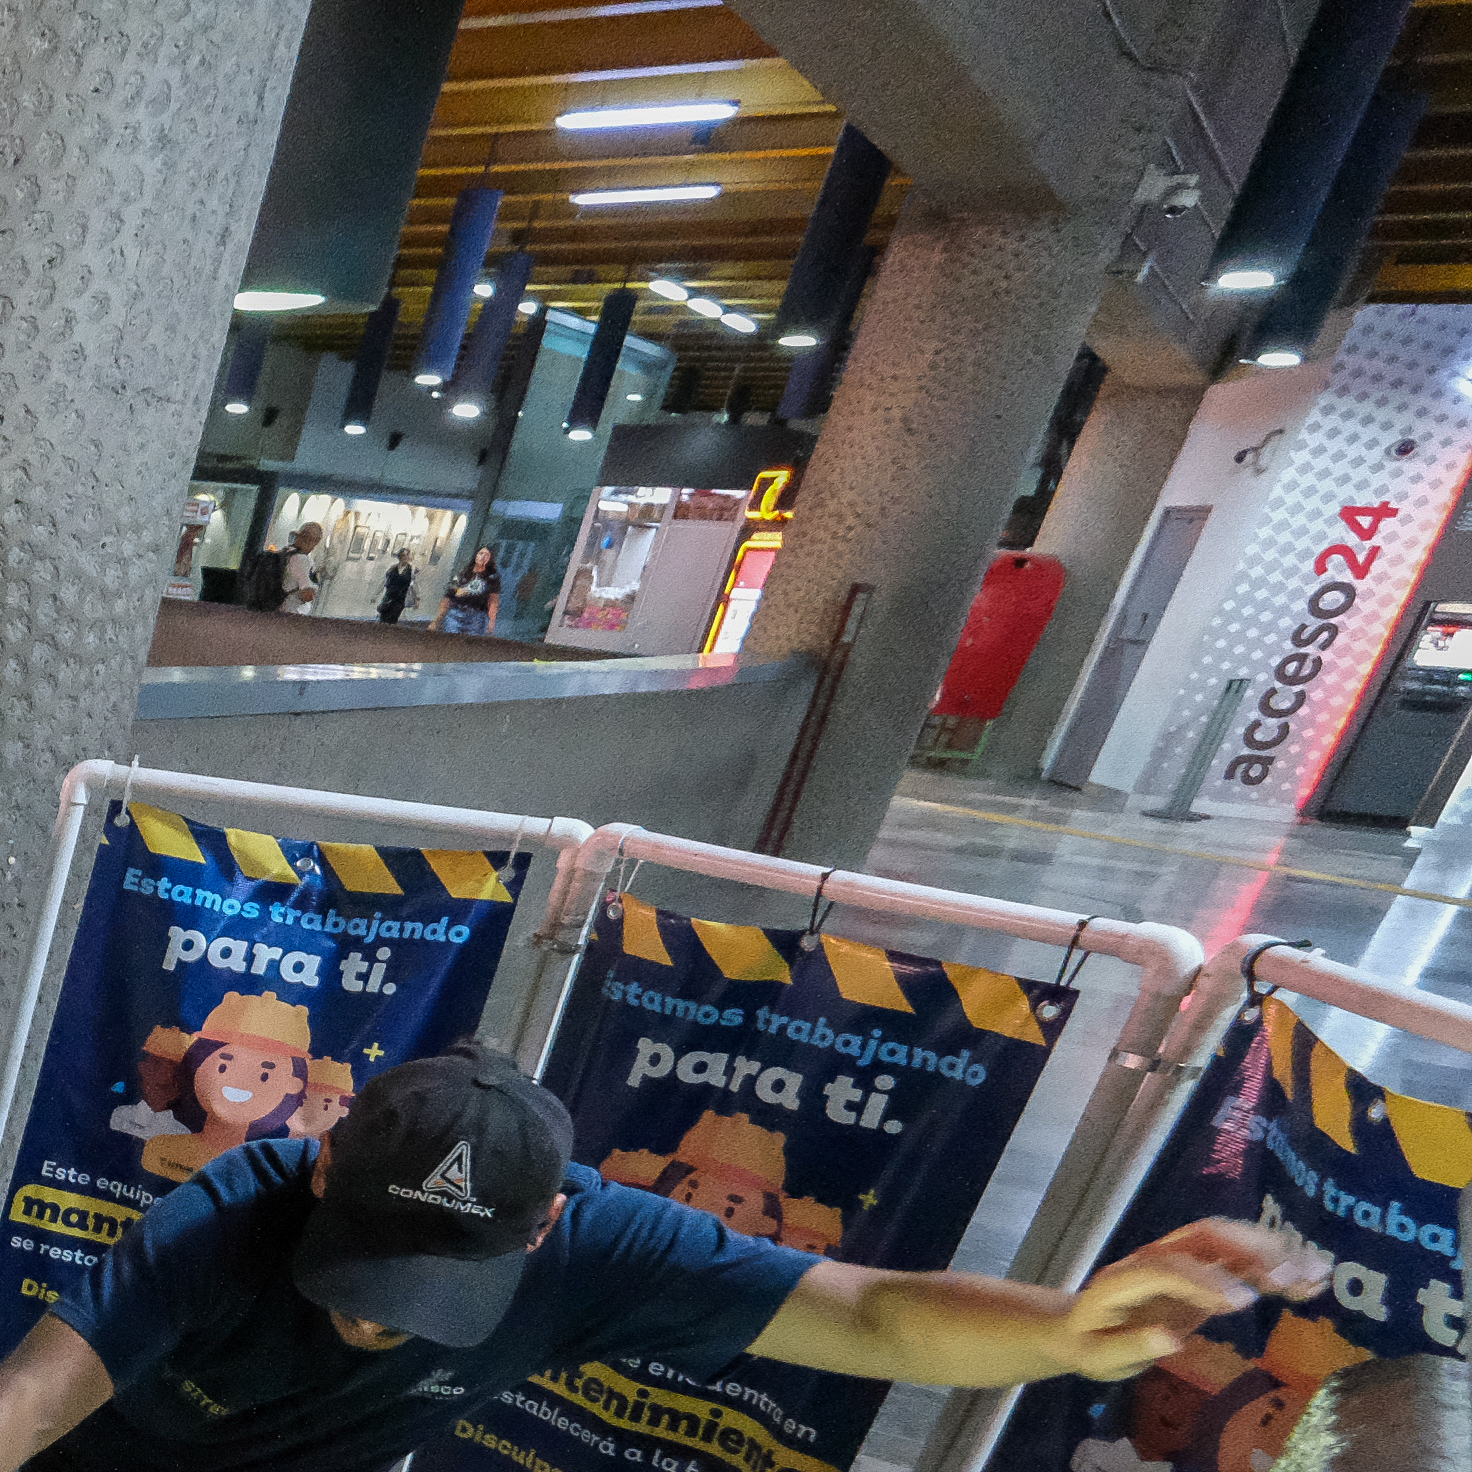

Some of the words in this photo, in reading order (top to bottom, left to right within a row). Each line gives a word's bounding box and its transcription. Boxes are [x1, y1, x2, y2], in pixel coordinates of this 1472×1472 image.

[1223, 500, 1400, 786] acceso24
[123, 867, 260, 919] Estamos
[269, 901, 471, 944] trabajando
[161, 926, 322, 987] para
[339, 946, 397, 995] ti.
[755, 1006, 987, 1086] trabajando
[626, 1037, 803, 1110] para
[823, 1074, 903, 1134] ti.
[41, 1160, 90, 1185] Este
[388, 1184, 496, 1218] CONDUMEX
[10, 1236, 34, 1251] se
[624, 1447, 643, 1462] a
